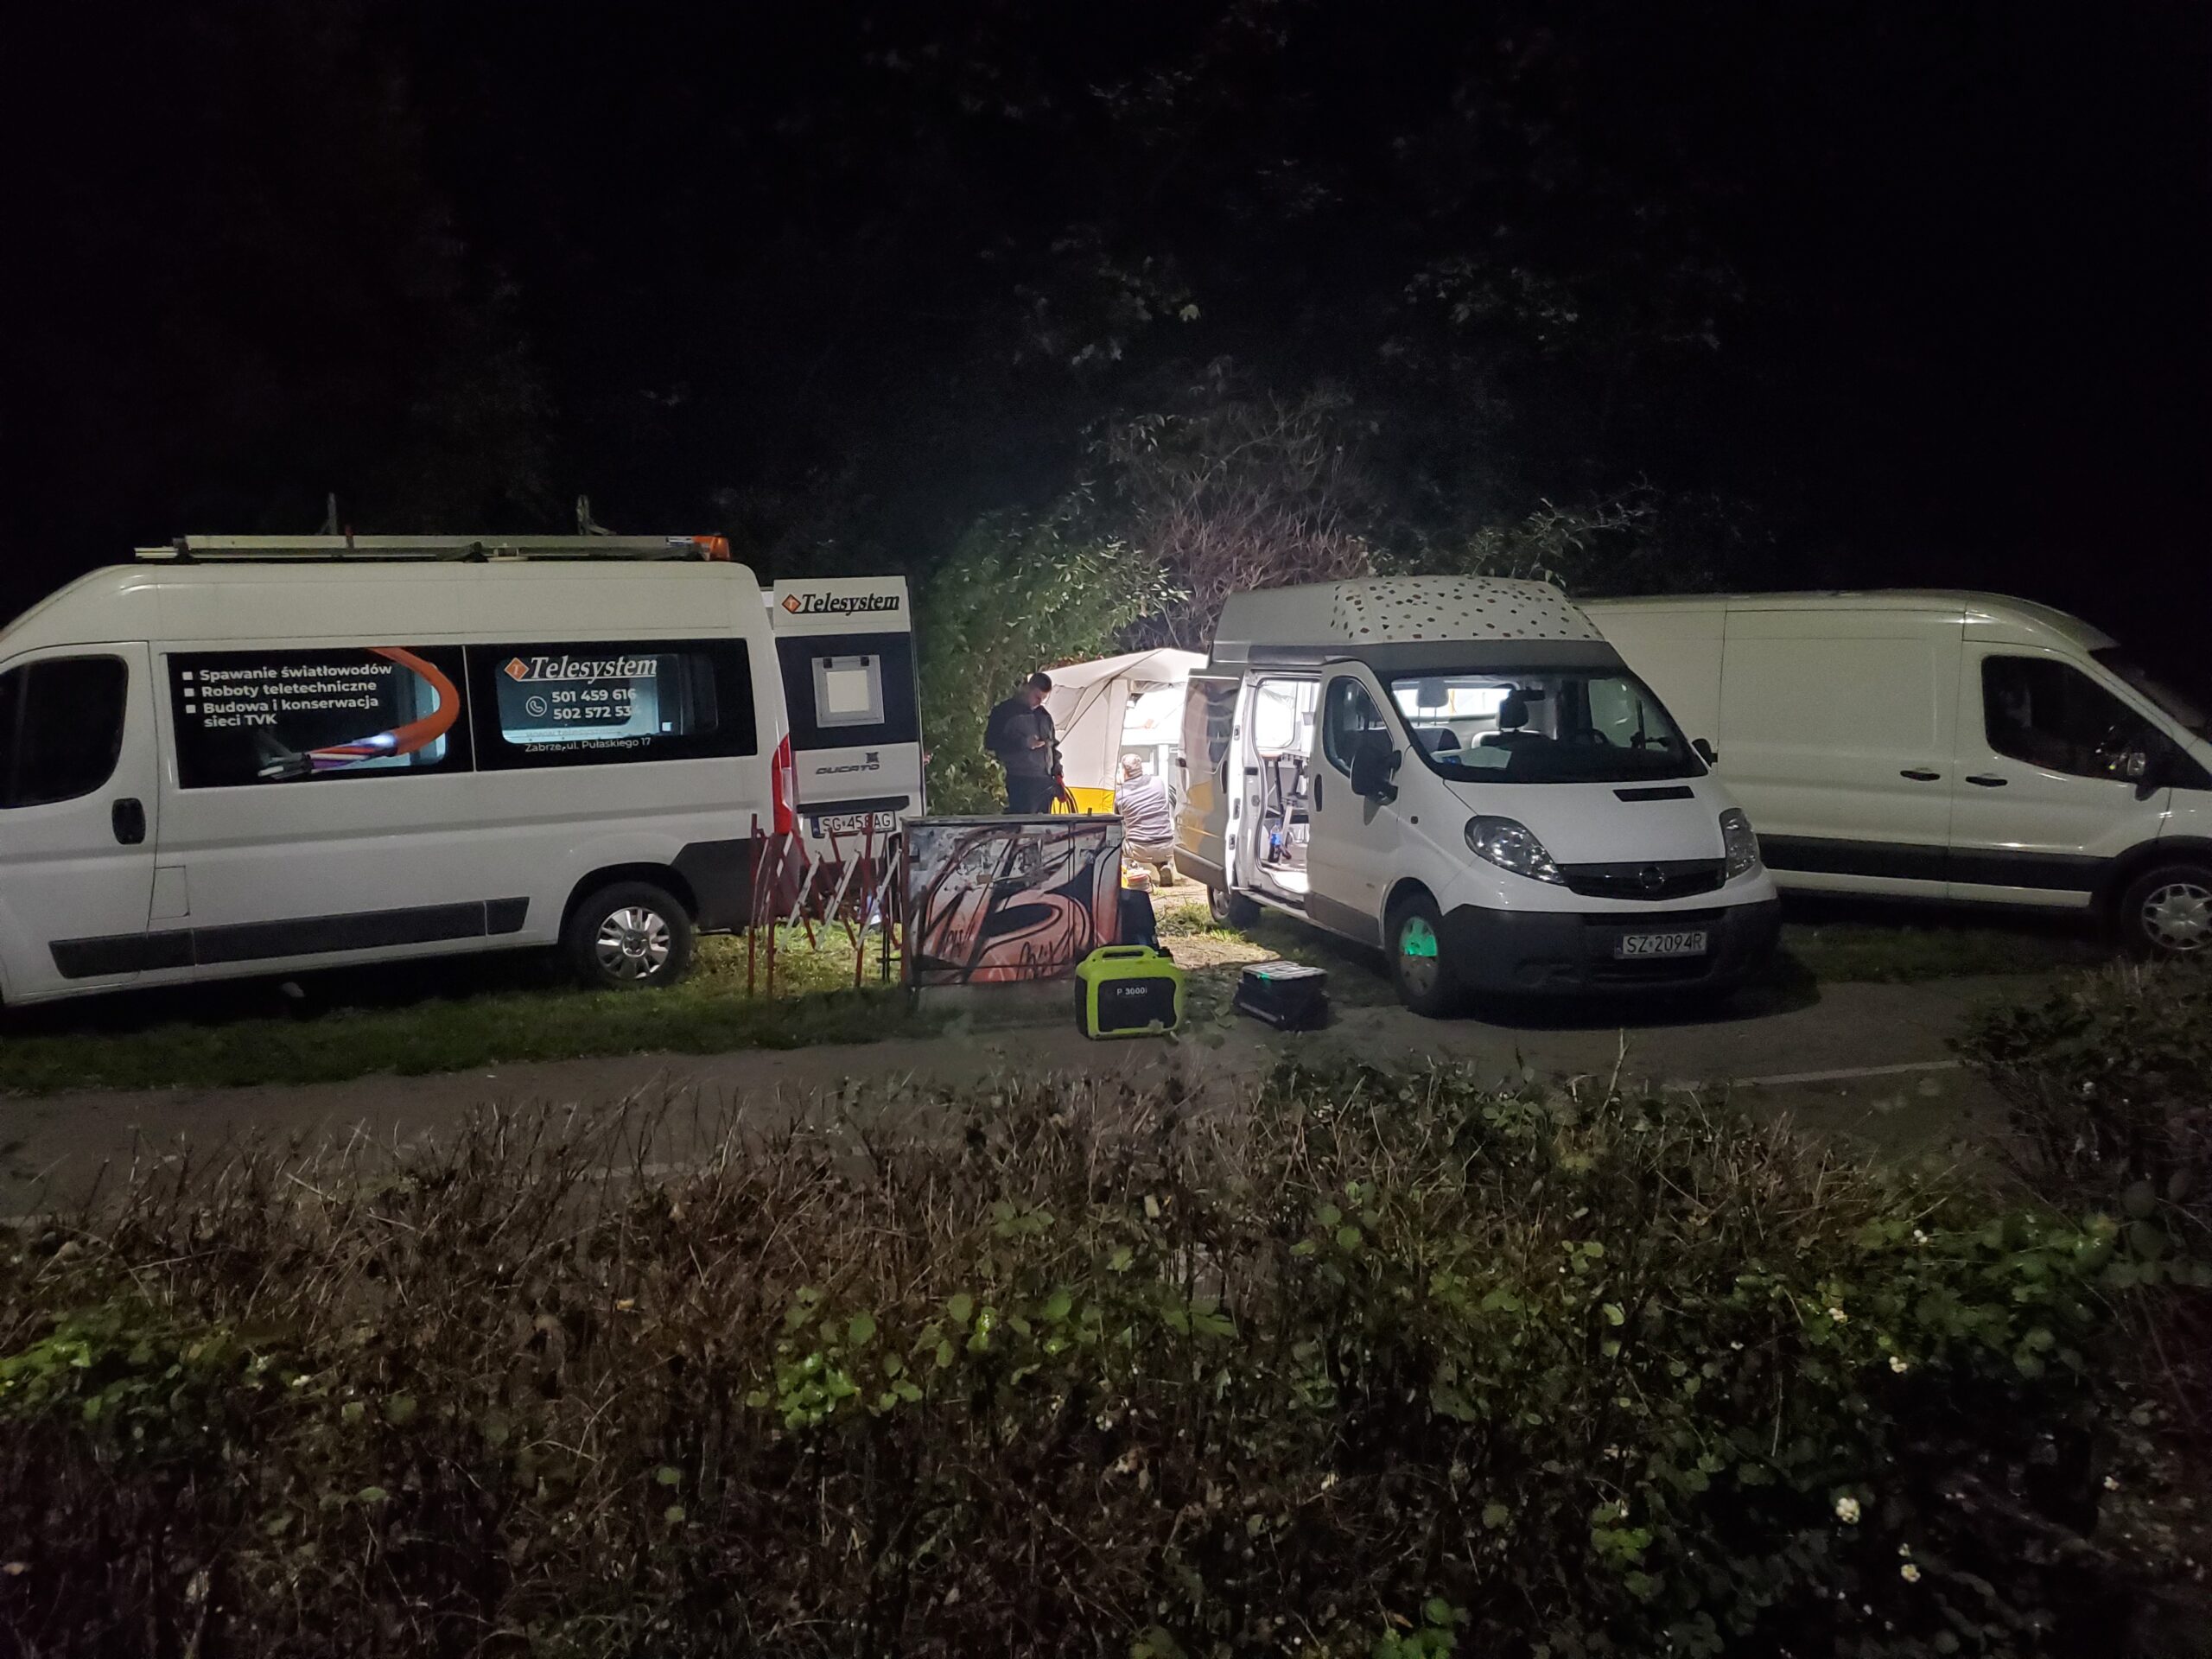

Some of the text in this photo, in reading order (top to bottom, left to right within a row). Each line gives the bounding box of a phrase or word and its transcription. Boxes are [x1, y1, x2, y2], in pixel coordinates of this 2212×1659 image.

[802, 592, 899, 615] Telesystem
[200, 663, 392, 683] Spawanie światłowodów
[530, 655, 658, 683] Telesystem
[201, 680, 377, 699] Roboty teletechniczne
[551, 690, 575, 702] 501
[581, 689, 608, 702] 459
[203, 696, 378, 715] Budowa i konserwacja
[553, 705, 640, 721] 502 572 53
[204, 713, 277, 728] sieci TVK
[567, 739, 579, 750] ul.
[582, 737, 639, 750] Pułaskiego
[641, 737, 652, 747] 17
[816, 764, 880, 775] DUCATO
[1627, 936, 1649, 953] SZ
[1116, 988, 1122, 996] P
